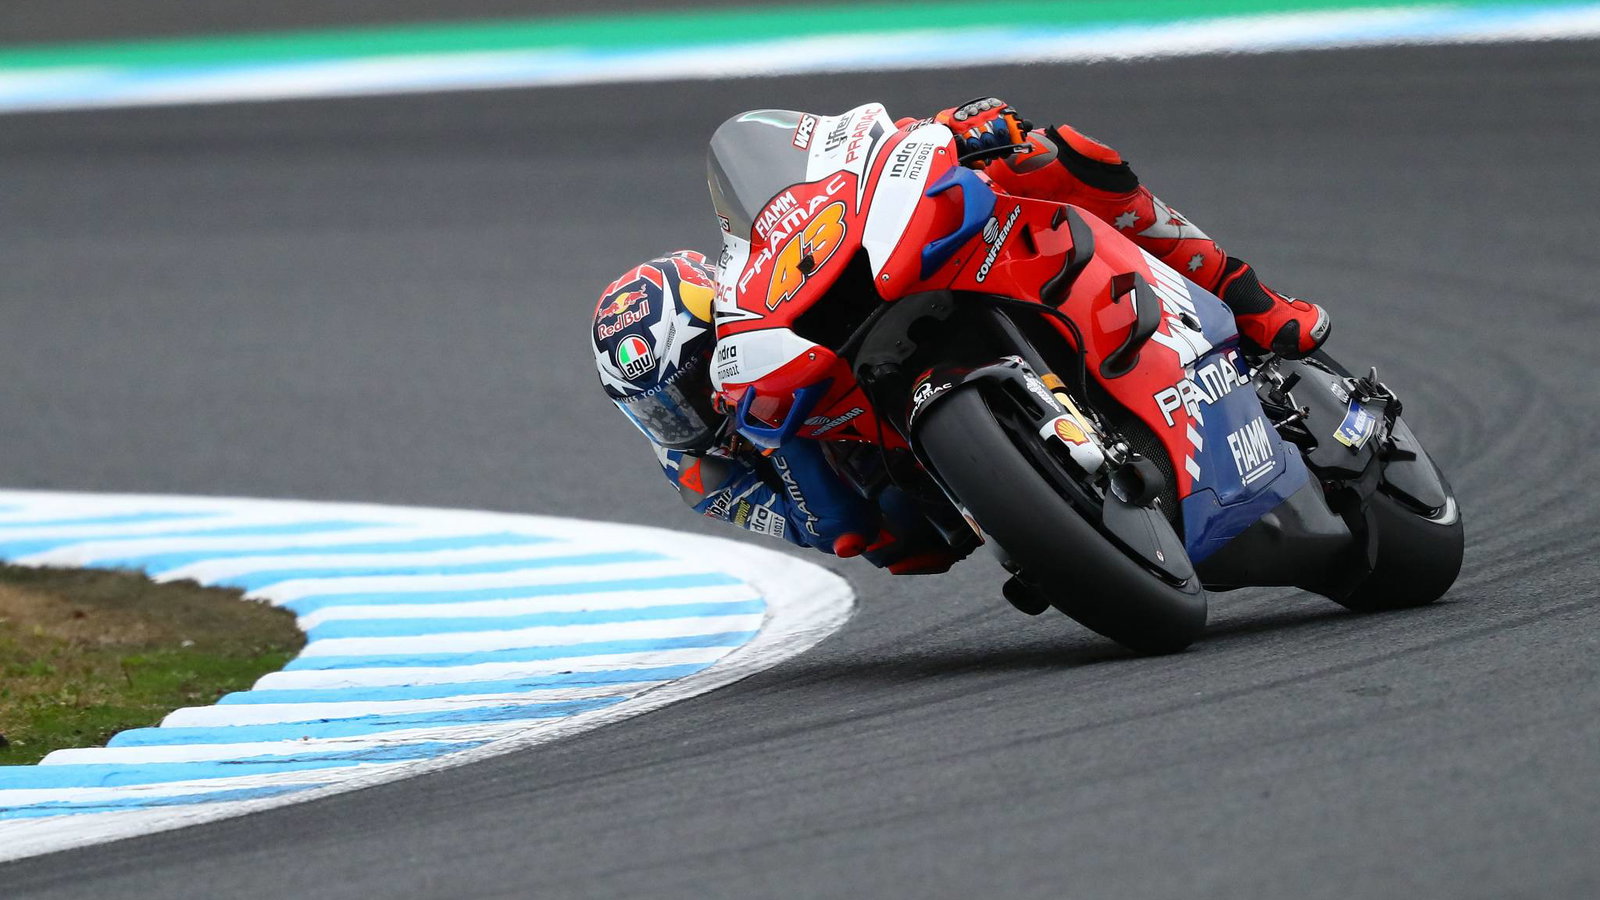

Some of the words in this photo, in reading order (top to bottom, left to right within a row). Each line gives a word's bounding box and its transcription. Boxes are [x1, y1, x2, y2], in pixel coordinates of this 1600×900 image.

[794, 114, 816, 150] WRS
[845, 108, 882, 164] PRAMAC
[739, 175, 846, 294] PRAMAC
[754, 191, 798, 239] FIAMM
[766, 201, 846, 311] 43
[976, 204, 1021, 282] CONFREMAR
[597, 317, 624, 340] Red
[622, 300, 650, 328] Bull
[626, 354, 651, 375] agv
[641, 385, 662, 398] YOU
[665, 356, 697, 385] WINGS
[1153, 350, 1249, 427] PRAMAC
[1227, 416, 1273, 476] FIAMM
[751, 508, 769, 532] dra
